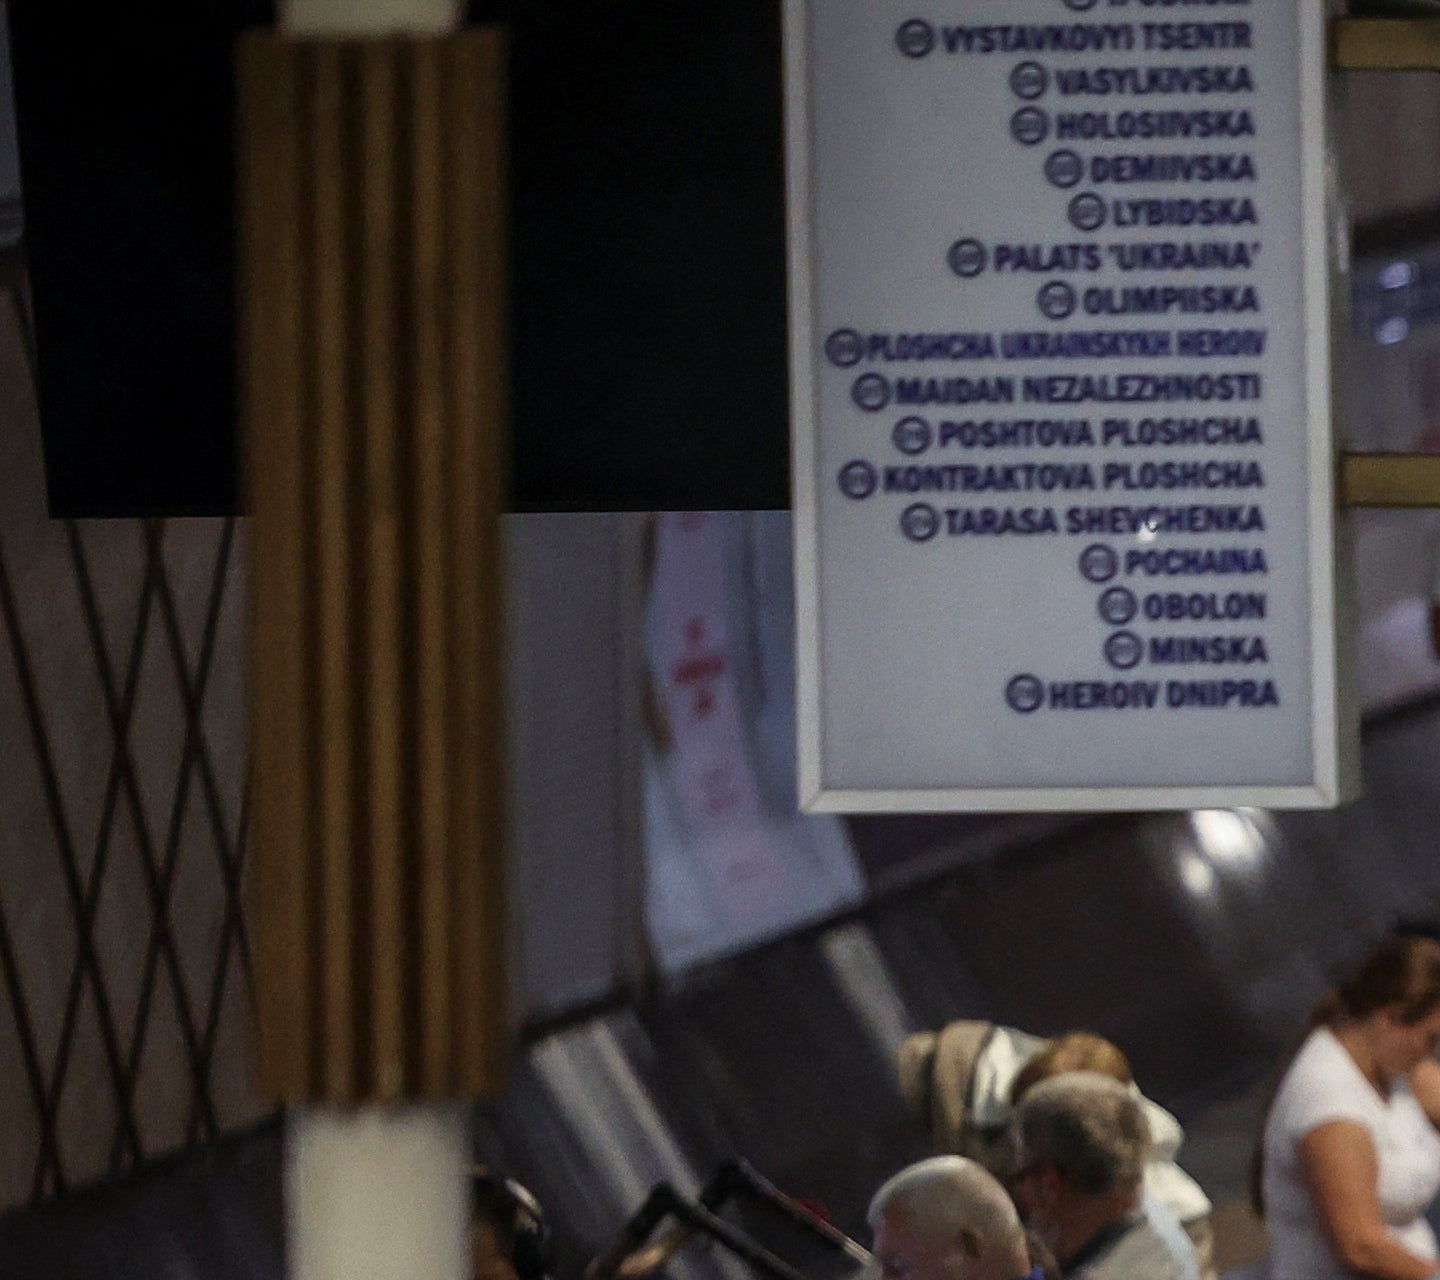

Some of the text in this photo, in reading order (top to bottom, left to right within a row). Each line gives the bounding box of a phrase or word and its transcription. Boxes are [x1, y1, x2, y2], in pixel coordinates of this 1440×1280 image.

[1142, 21, 1253, 51] TSENTR
[1054, 110, 1256, 140] HOLOSIIVSKA
[1089, 154, 1257, 184] DEMIIVSKA
[1111, 197, 1258, 228] LYBIDSKA
[993, 243, 1102, 273] PALATS
[1082, 285, 1260, 316] OLIMPIISKA
[895, 373, 1261, 406] MAIDAN NEZALEZHNOSTI
[938, 417, 1263, 449] POSHTOVA PLOSHCHA
[882, 461, 1265, 494] KONTRAKTOVA PLOSHCHA
[944, 505, 1265, 536] TARASA SHEVCHENKA
[1124, 548, 1268, 577] POCHAINA
[1142, 592, 1267, 621] OBOLON
[1148, 636, 1268, 665] MINSKA
[1048, 679, 1280, 710] HEROIV DNIPRA
